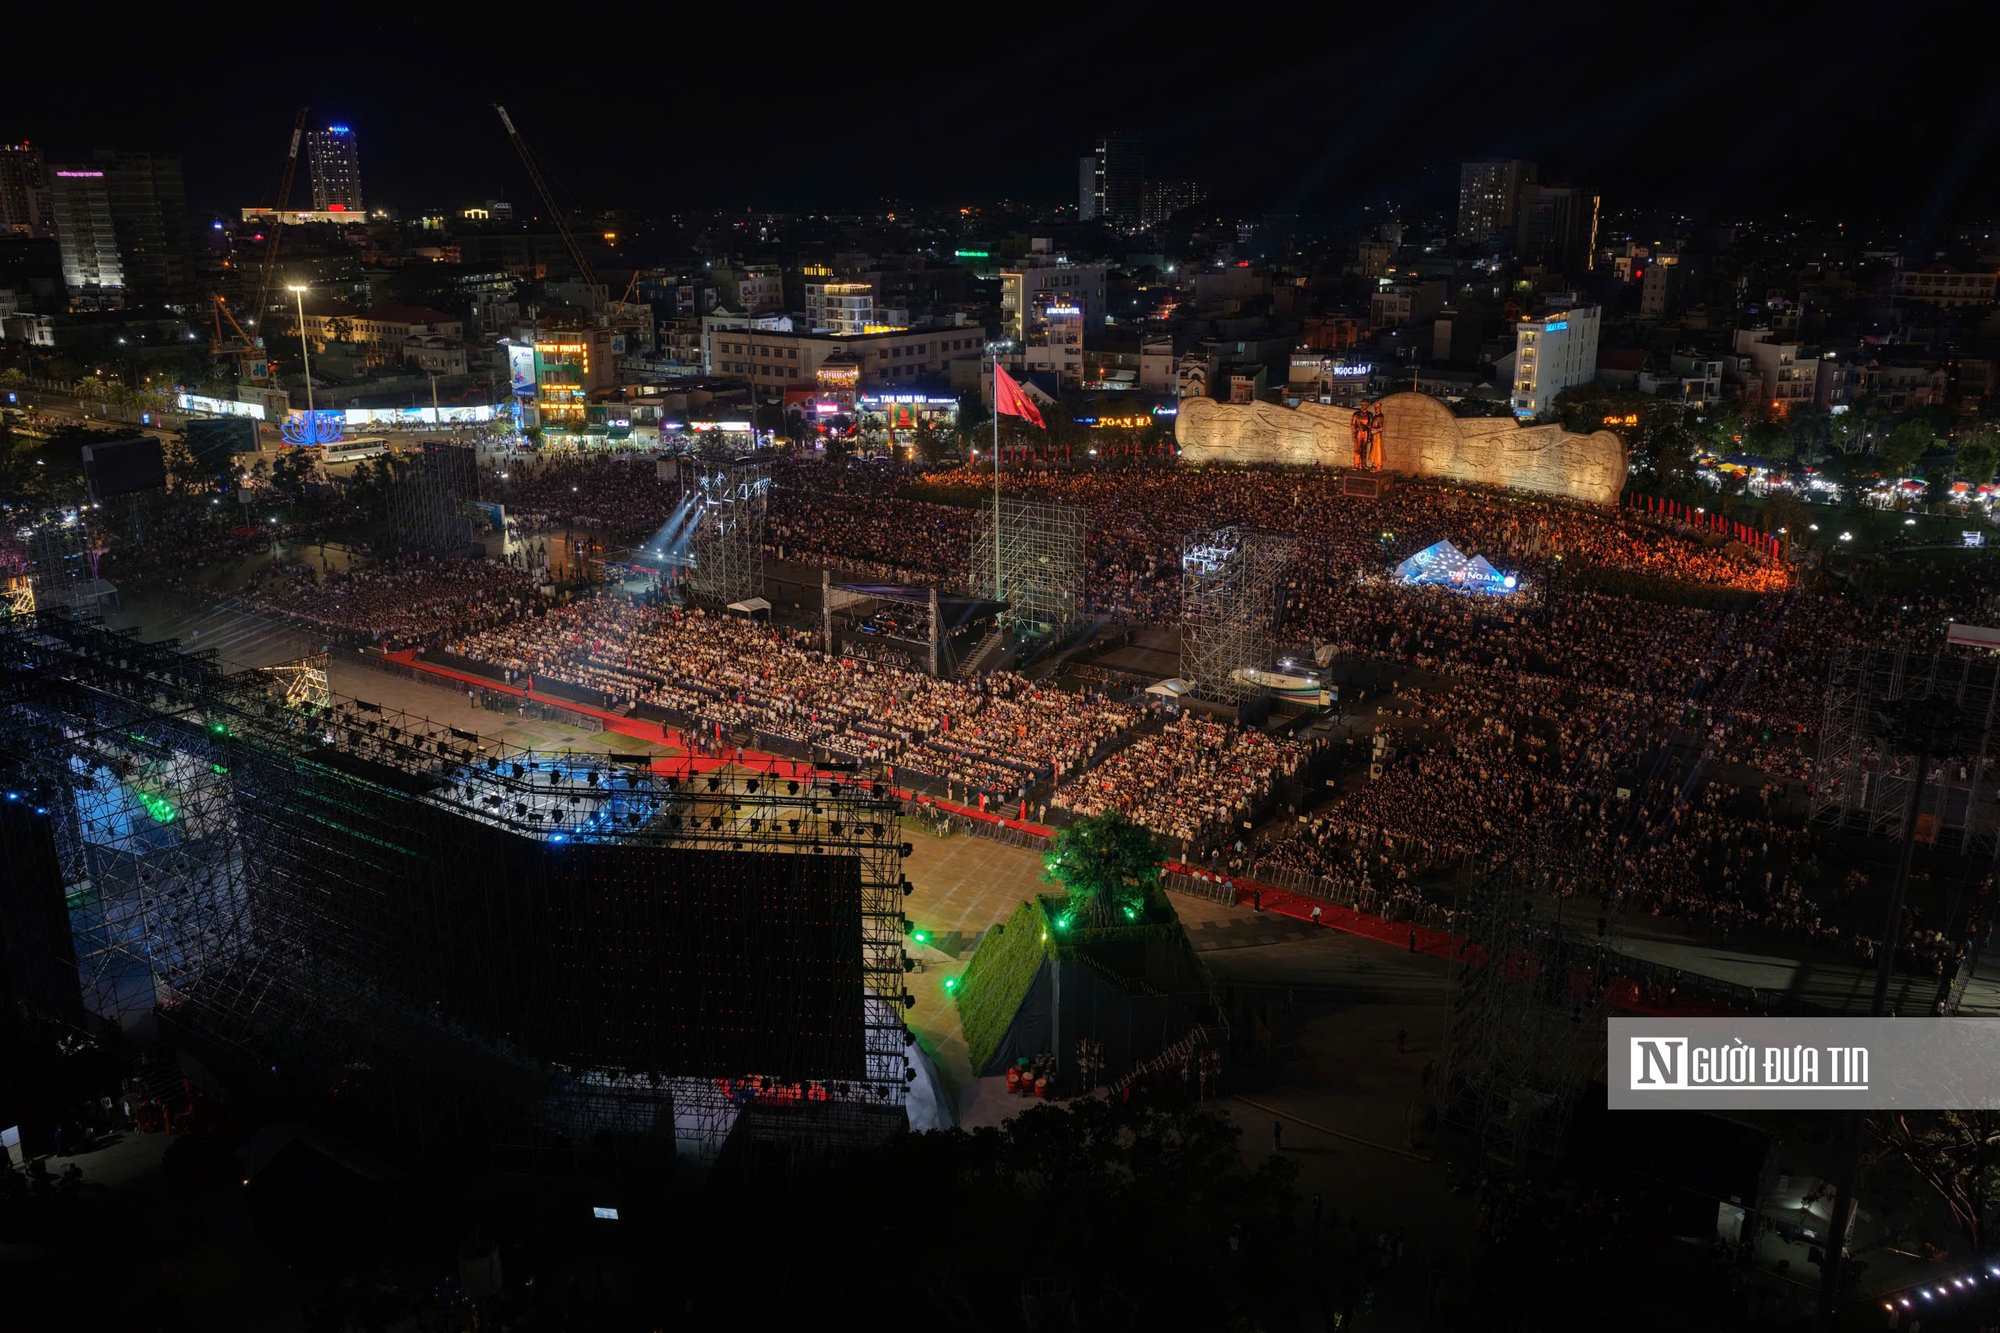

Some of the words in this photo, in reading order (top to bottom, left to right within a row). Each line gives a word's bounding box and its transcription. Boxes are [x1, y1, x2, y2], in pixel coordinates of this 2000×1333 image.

[535, 344, 558, 352] SYDNEY
[559, 344, 581, 352] FRUITS
[1333, 366, 1353, 376] NGỌC
